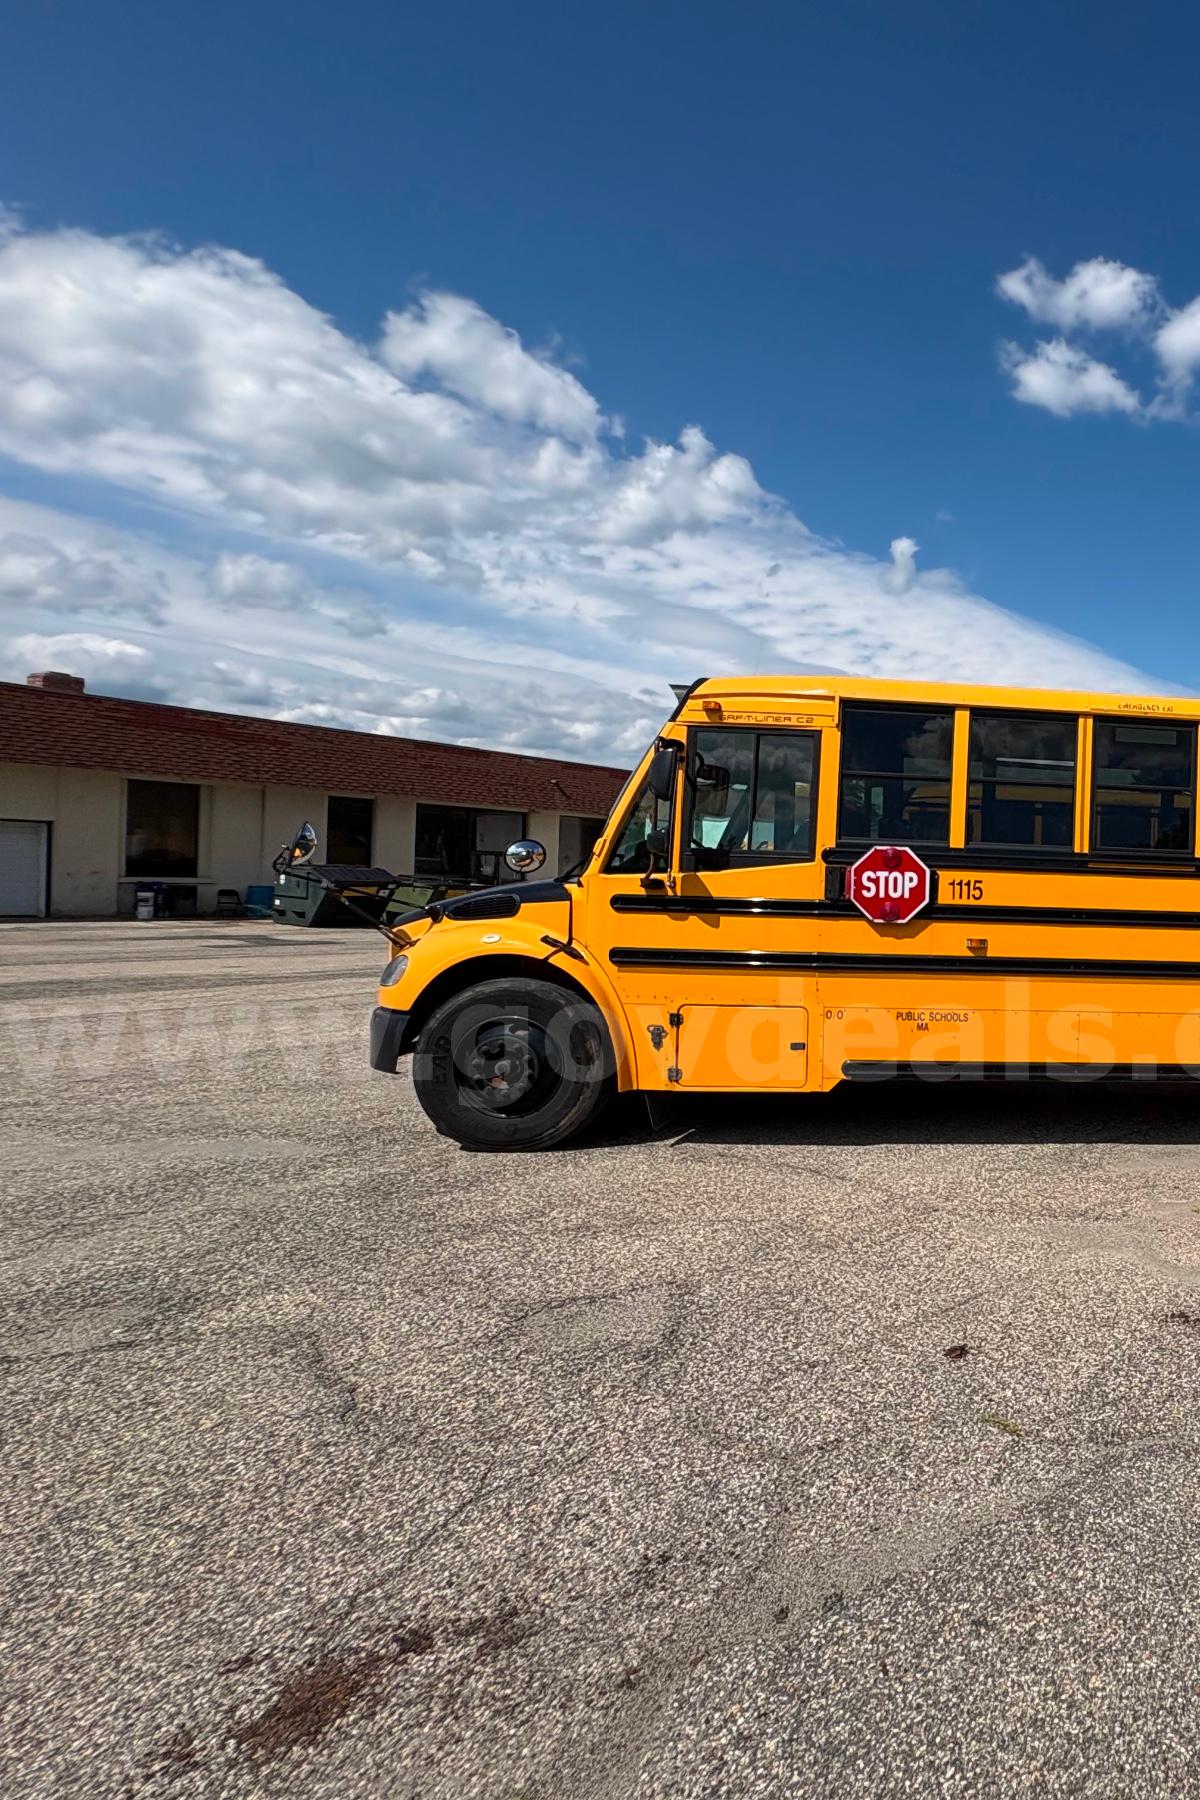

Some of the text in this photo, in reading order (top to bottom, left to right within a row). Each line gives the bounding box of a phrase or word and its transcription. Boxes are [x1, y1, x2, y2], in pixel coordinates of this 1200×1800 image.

[796, 716, 814, 724] C2
[861, 871, 919, 899] STOP
[948, 879, 984, 901] 1115
[896, 1011, 969, 1023] PUBLIC SCHOOLS
[916, 1022, 930, 1032] MA
